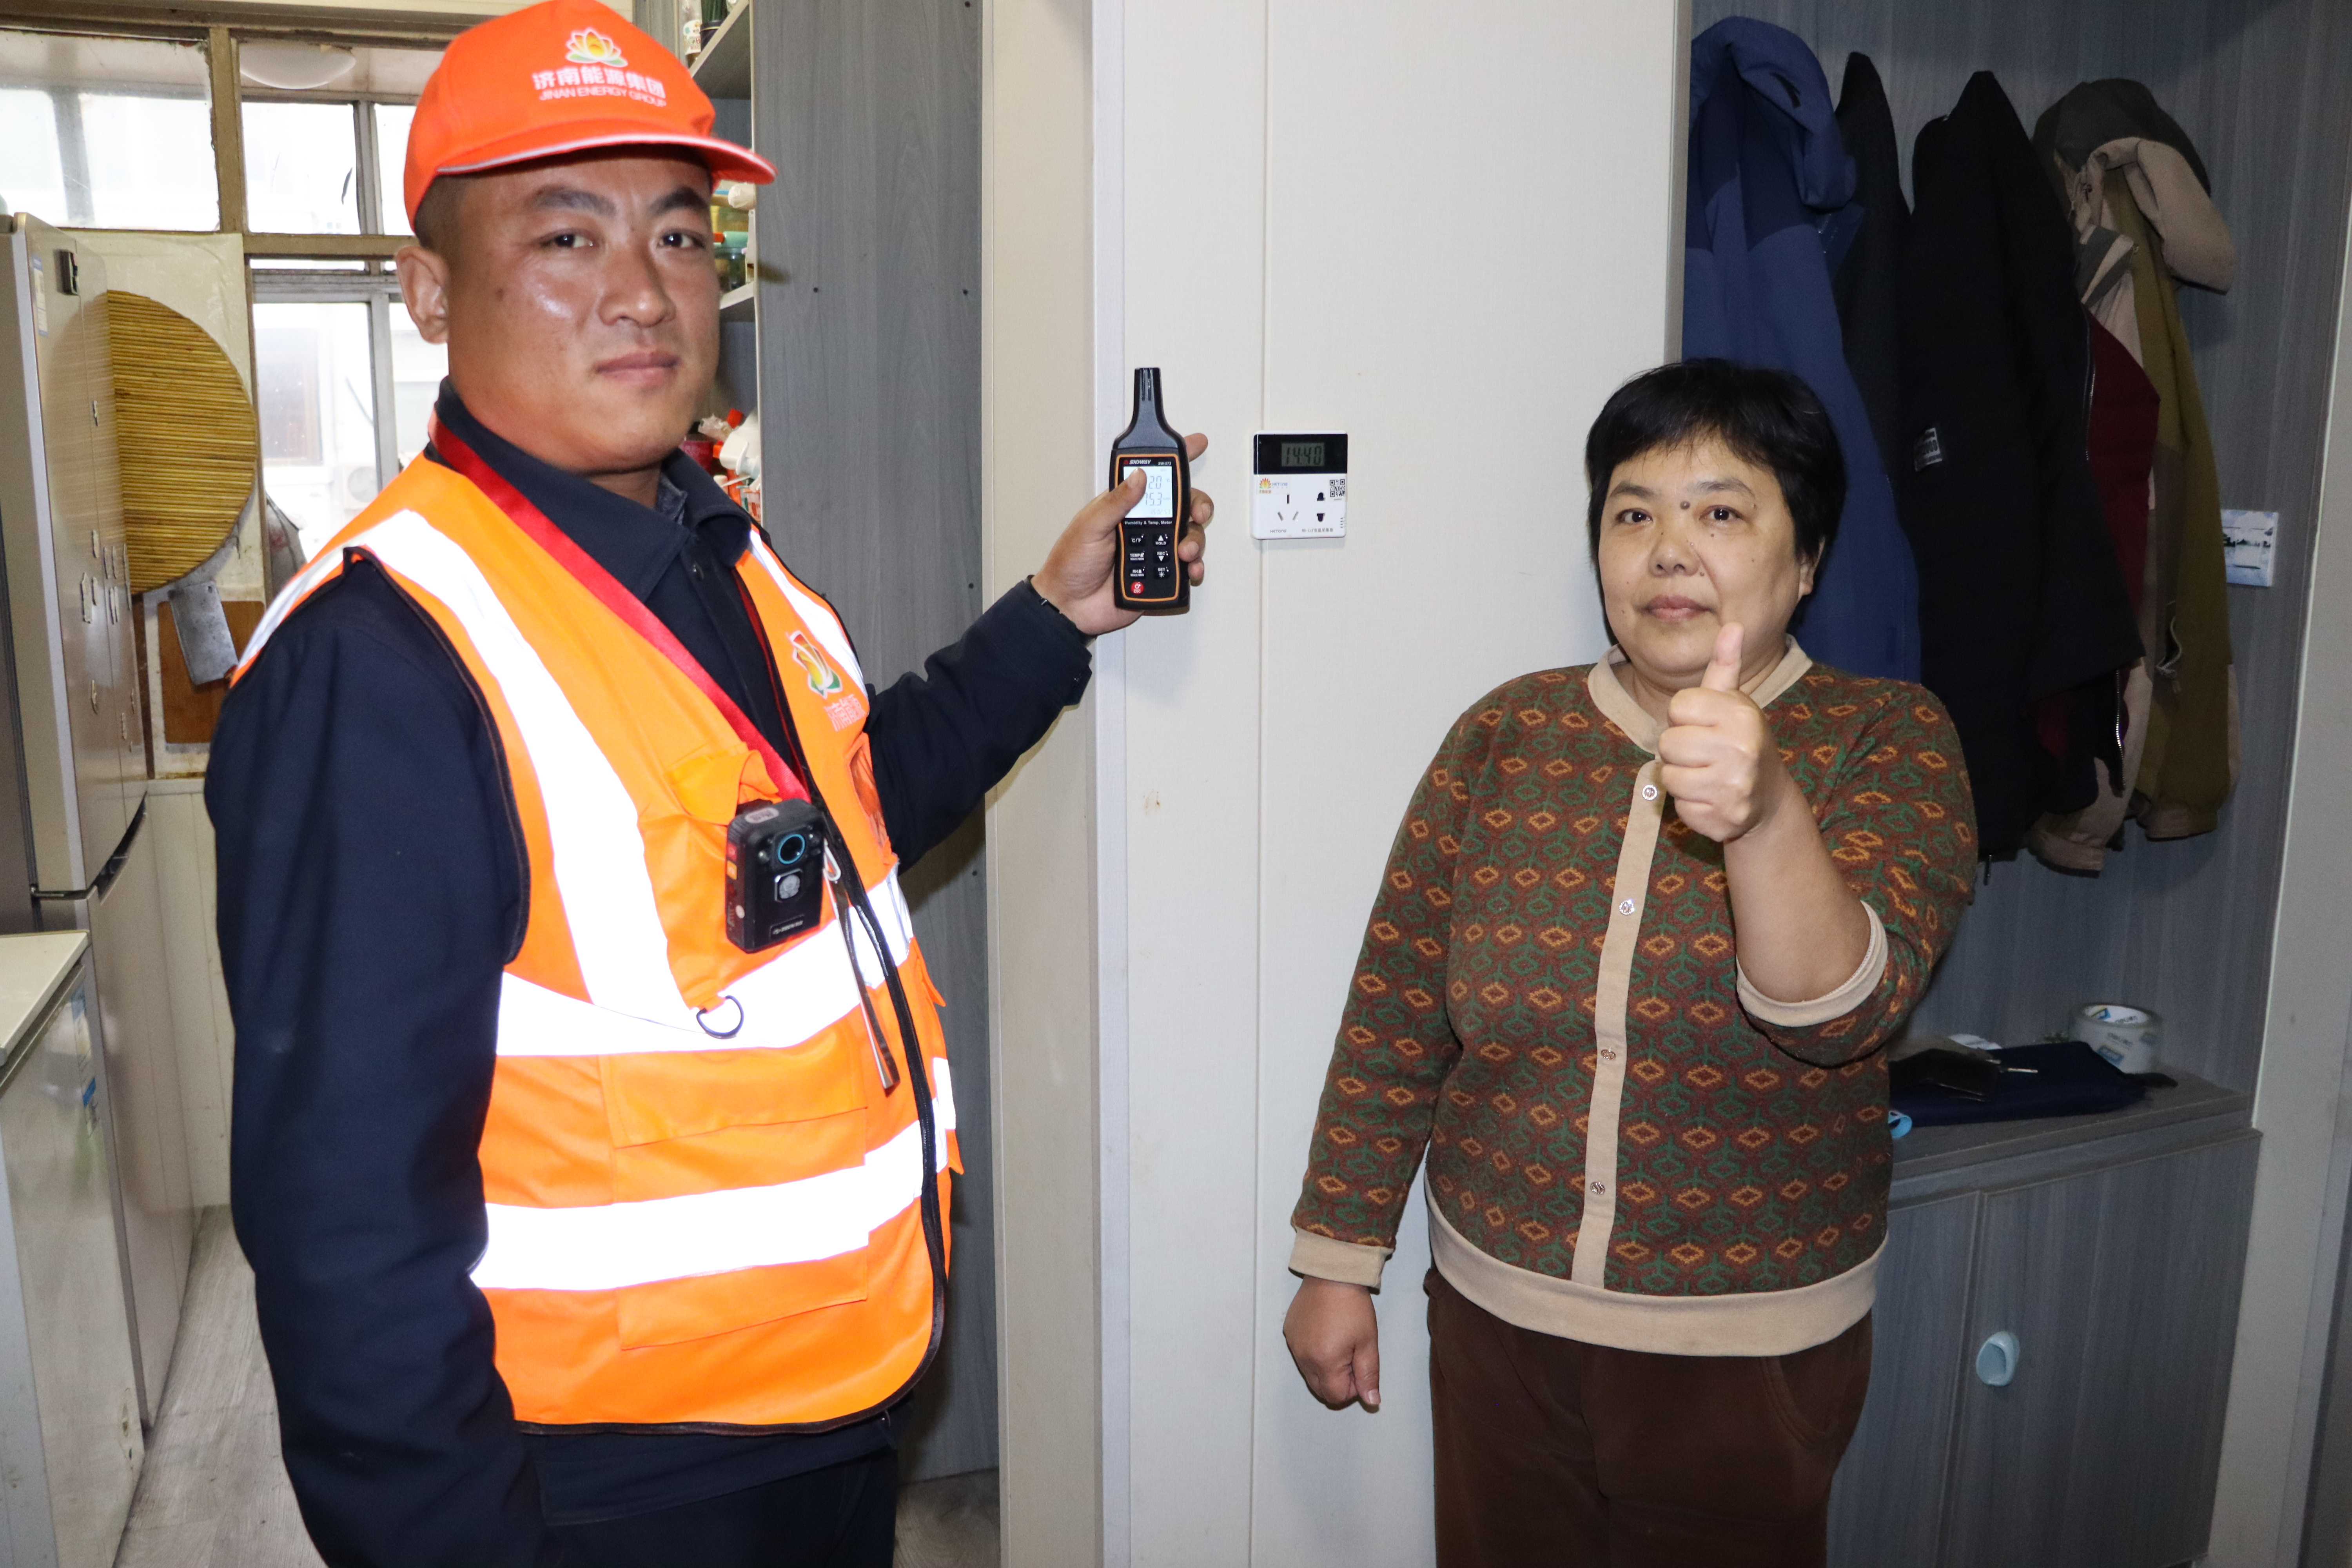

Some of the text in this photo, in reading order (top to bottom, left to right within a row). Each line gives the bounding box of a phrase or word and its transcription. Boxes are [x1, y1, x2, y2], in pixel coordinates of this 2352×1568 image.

[532, 65, 666, 99] 济南能源集团
[539, 86, 666, 107] JINAN ENERGY GROUP
